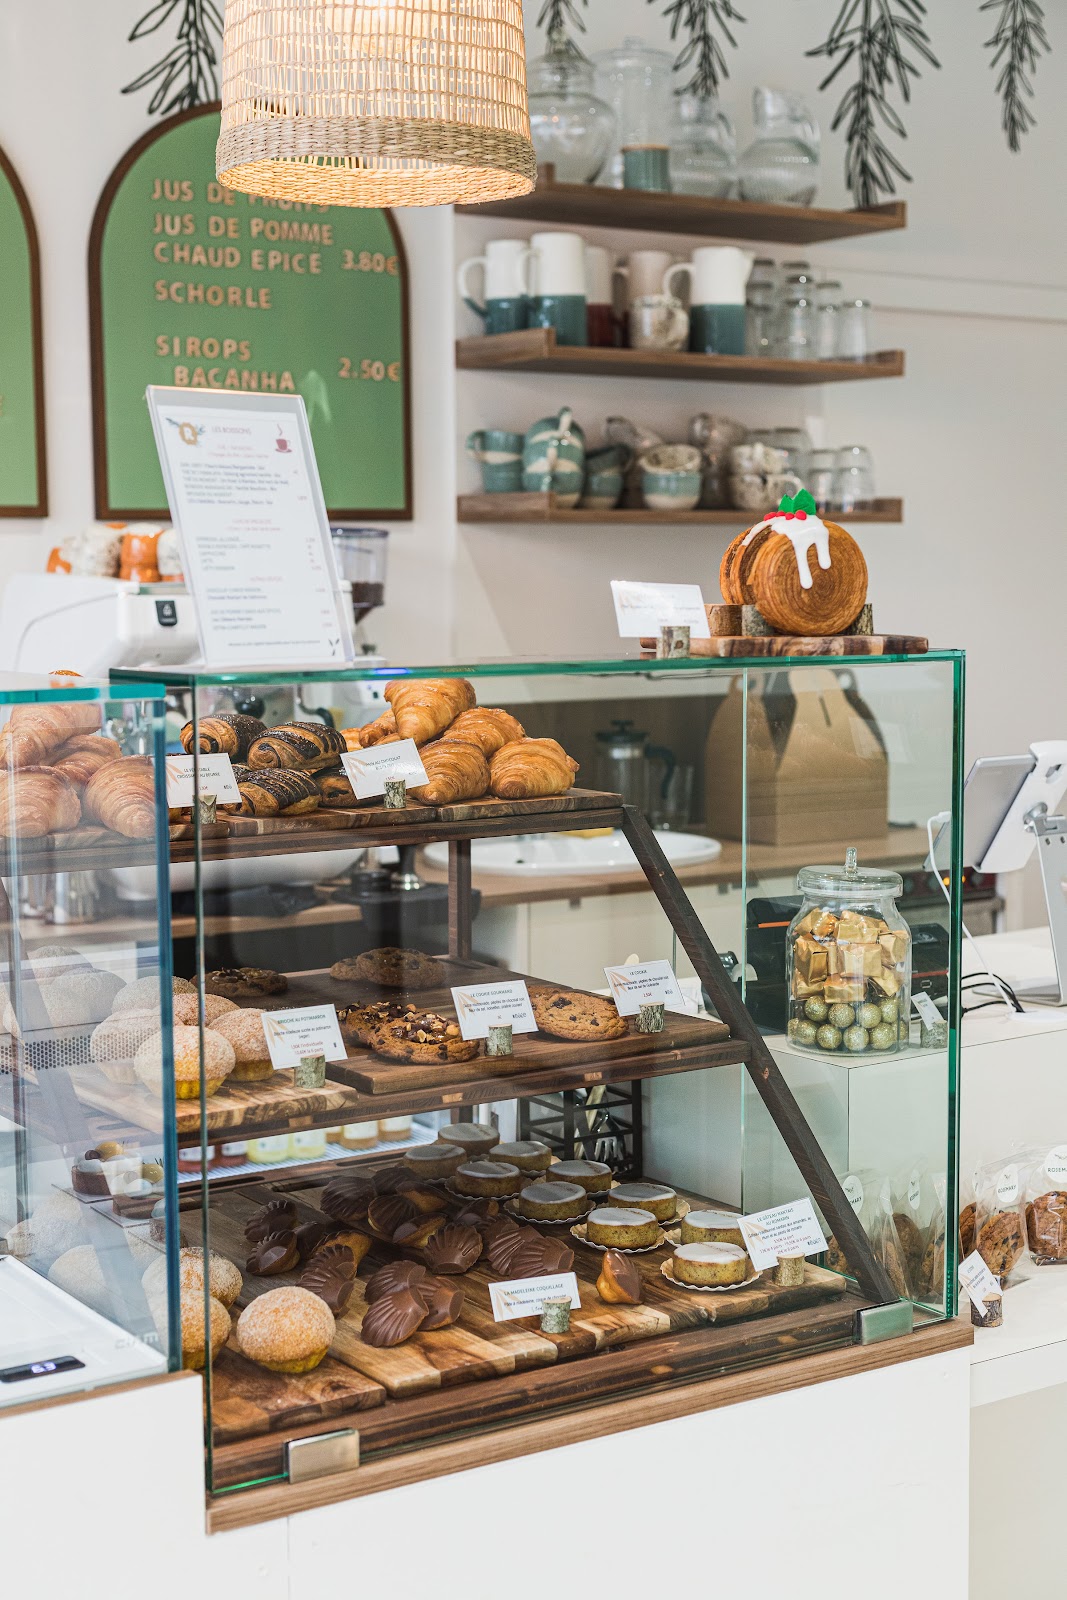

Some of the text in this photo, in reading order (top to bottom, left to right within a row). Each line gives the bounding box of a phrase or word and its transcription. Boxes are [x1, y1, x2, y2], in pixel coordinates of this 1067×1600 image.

[152, 178, 194, 202] JUS
[207, 182, 236, 206] DE
[153, 213, 333, 245] JUS DE POMME
[154, 242, 240, 268] CHAUD
[155, 279, 272, 309] SCHORLE
[156, 335, 251, 361] SIROPS
[174, 365, 295, 391] BACANHA
